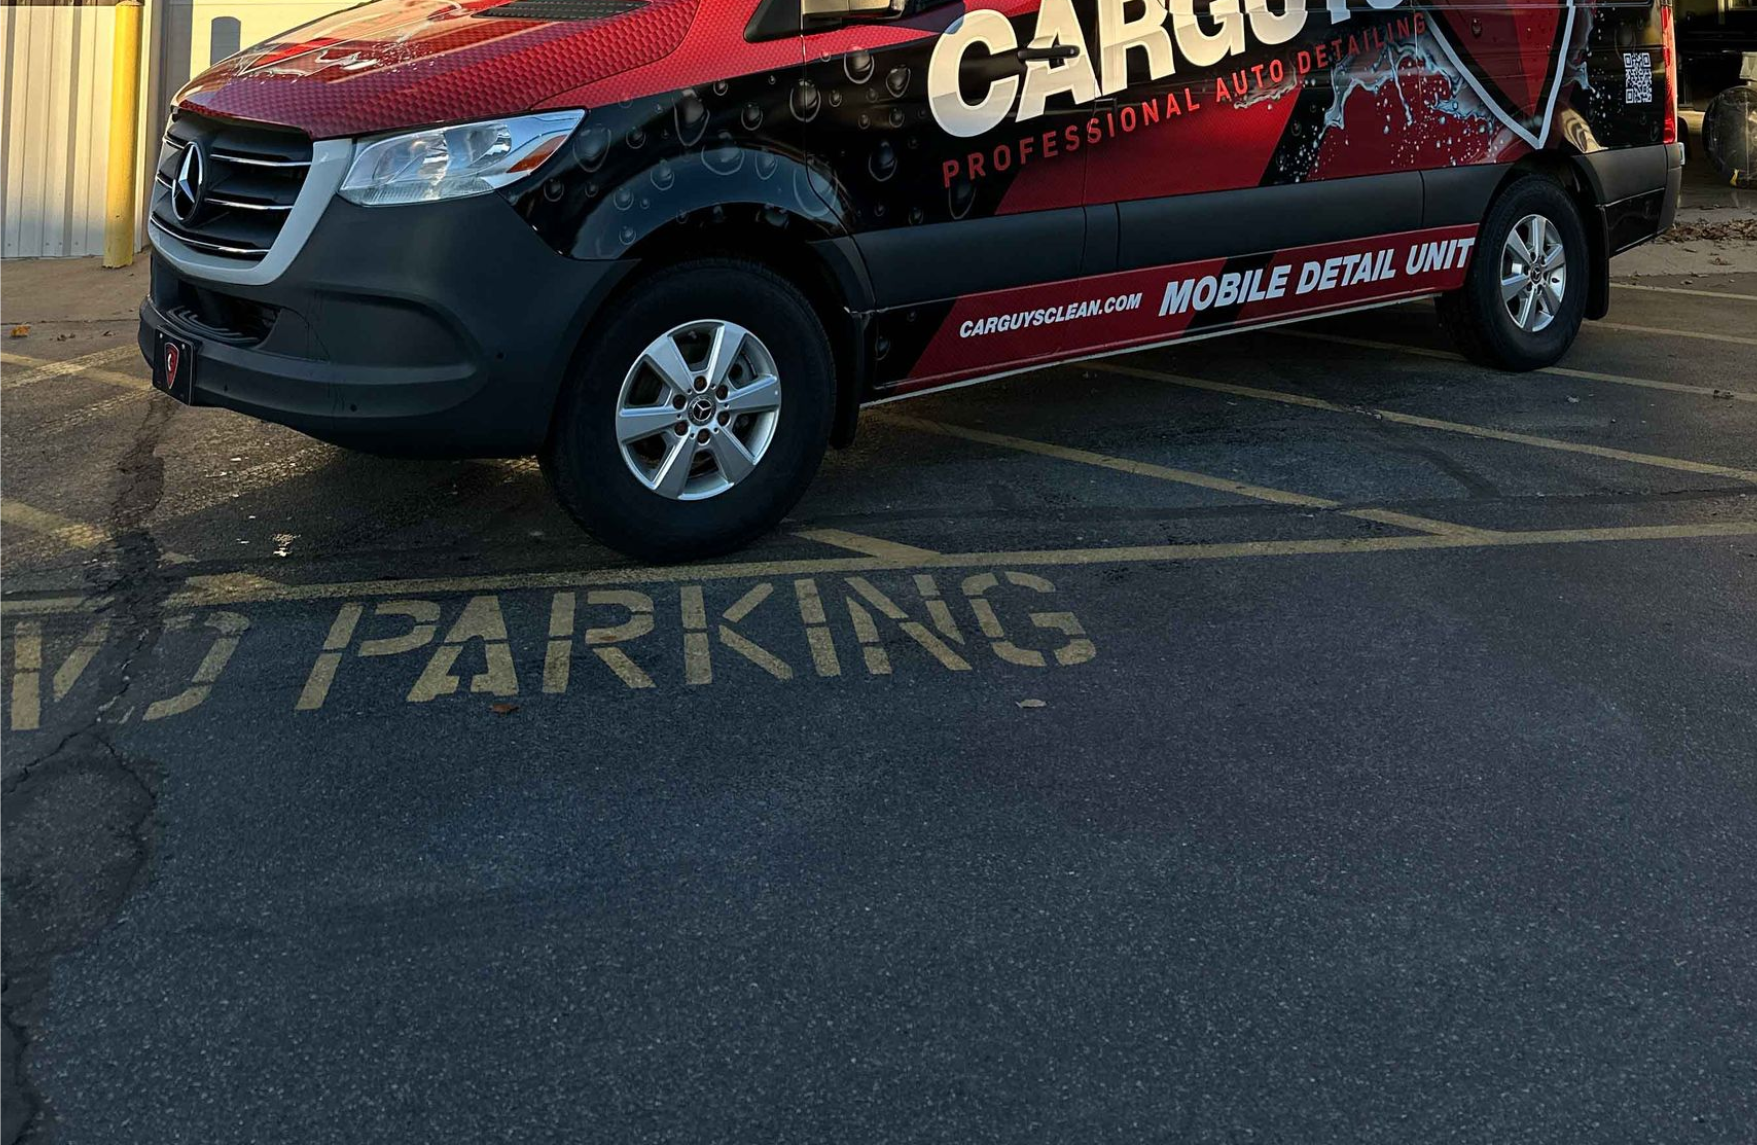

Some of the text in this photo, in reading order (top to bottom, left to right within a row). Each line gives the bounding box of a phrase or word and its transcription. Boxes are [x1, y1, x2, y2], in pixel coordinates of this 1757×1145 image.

[942, 11, 1427, 189] PROFESSIONAL AUTO DETAILING
[958, 236, 1476, 340] CARGUYSCLEAN.COM MOBILE DETAIL UNIT
[294, 570, 1097, 711] PARKING
